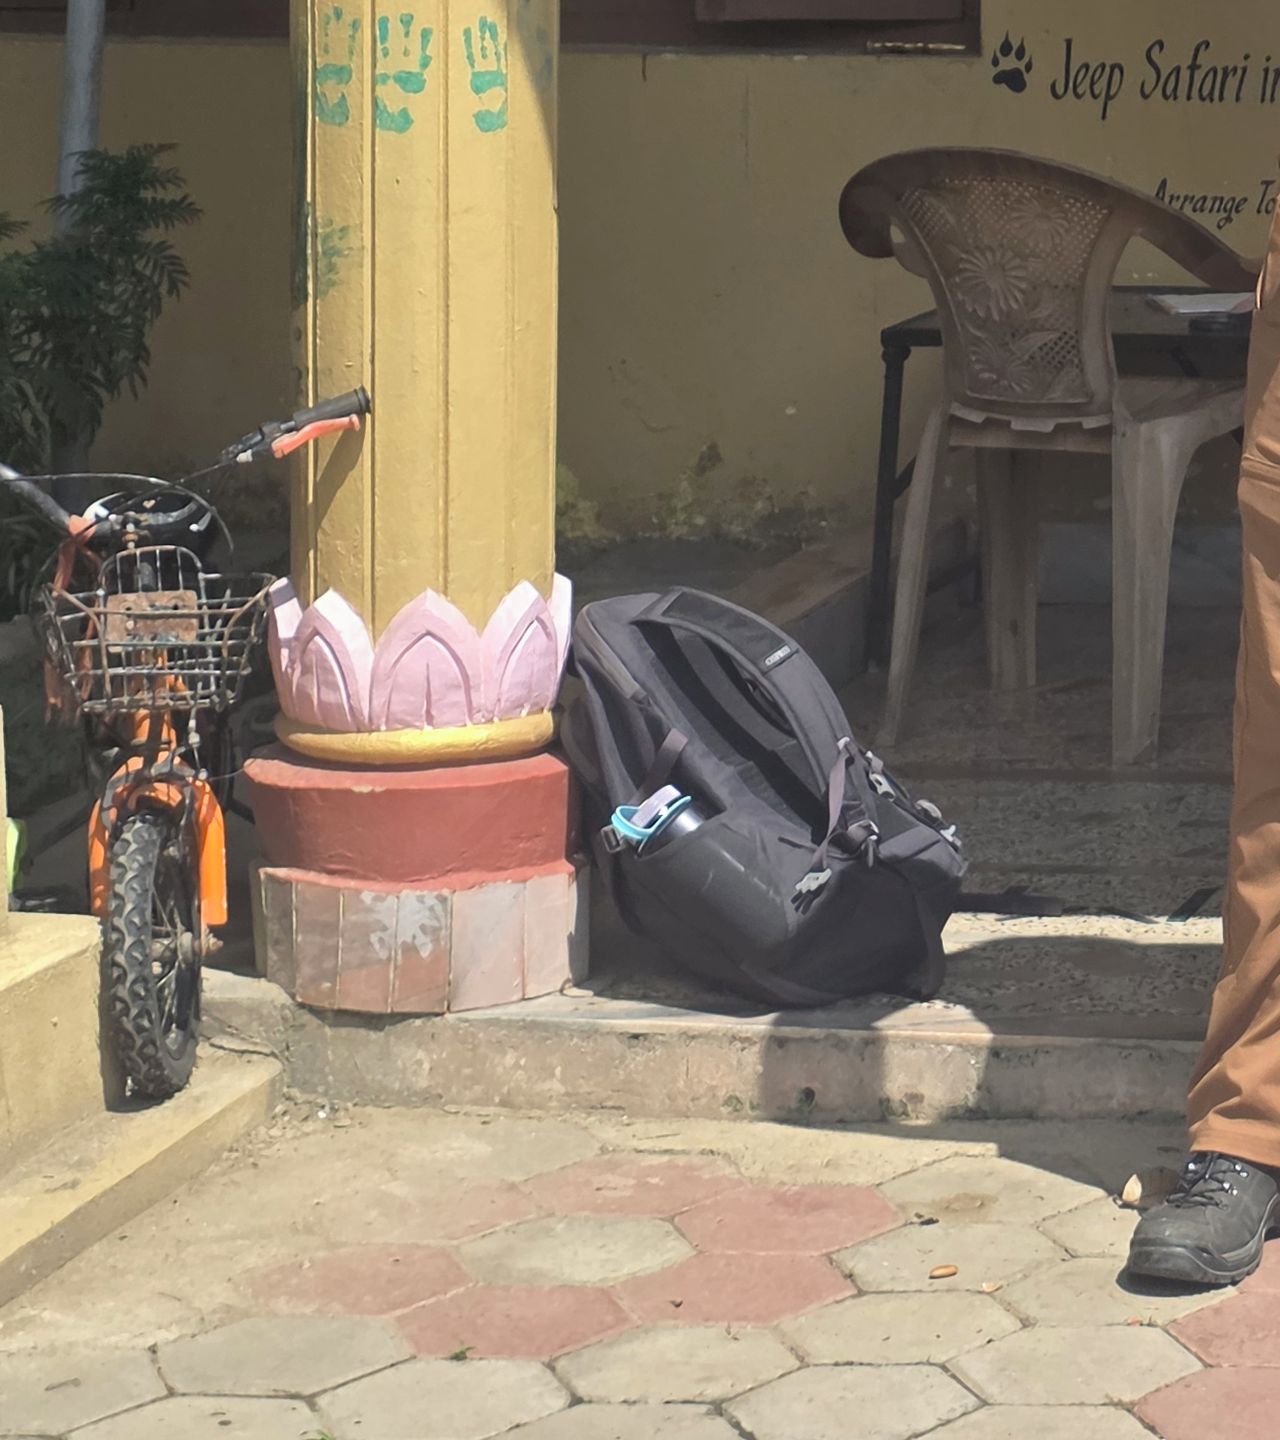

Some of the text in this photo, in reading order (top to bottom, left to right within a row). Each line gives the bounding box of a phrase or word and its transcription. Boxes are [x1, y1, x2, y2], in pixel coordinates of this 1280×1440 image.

[1050, 38, 1124, 121] Jeep
[1140, 39, 1251, 104] Safari
[1154, 177, 1249, 230] Arrange
